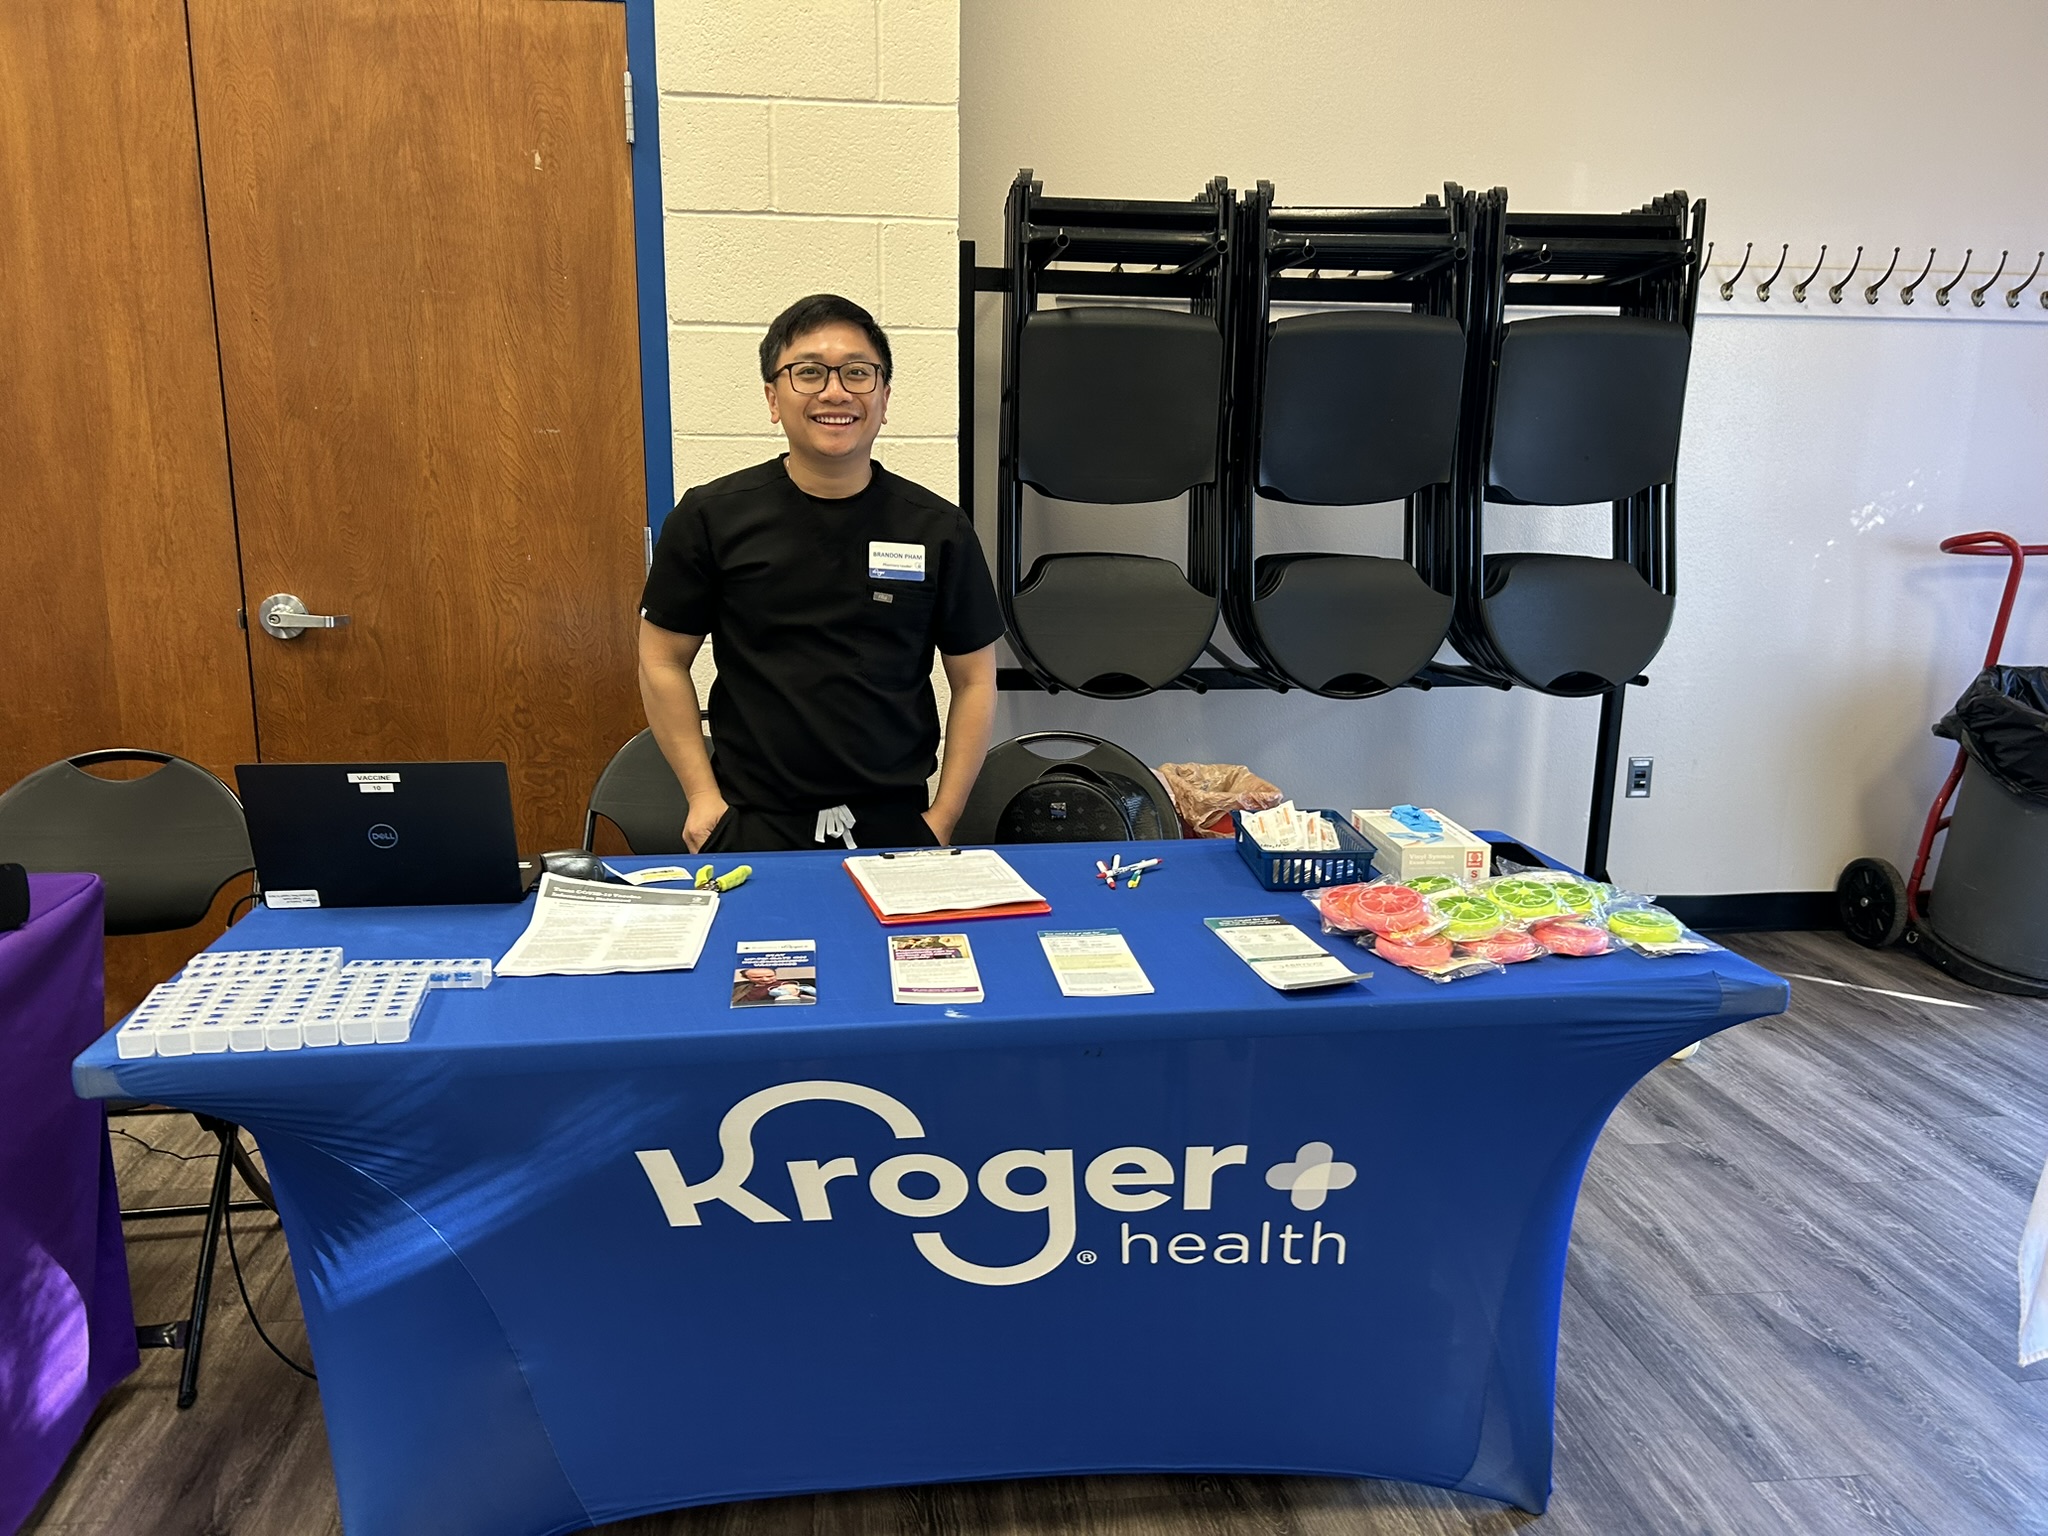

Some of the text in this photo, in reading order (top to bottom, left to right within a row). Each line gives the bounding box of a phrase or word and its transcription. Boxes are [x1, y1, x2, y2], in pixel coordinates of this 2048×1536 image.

[1471, 870, 1478, 878] S
[634, 1080, 1248, 1286] Kroger
[1120, 1220, 1346, 1264] health
